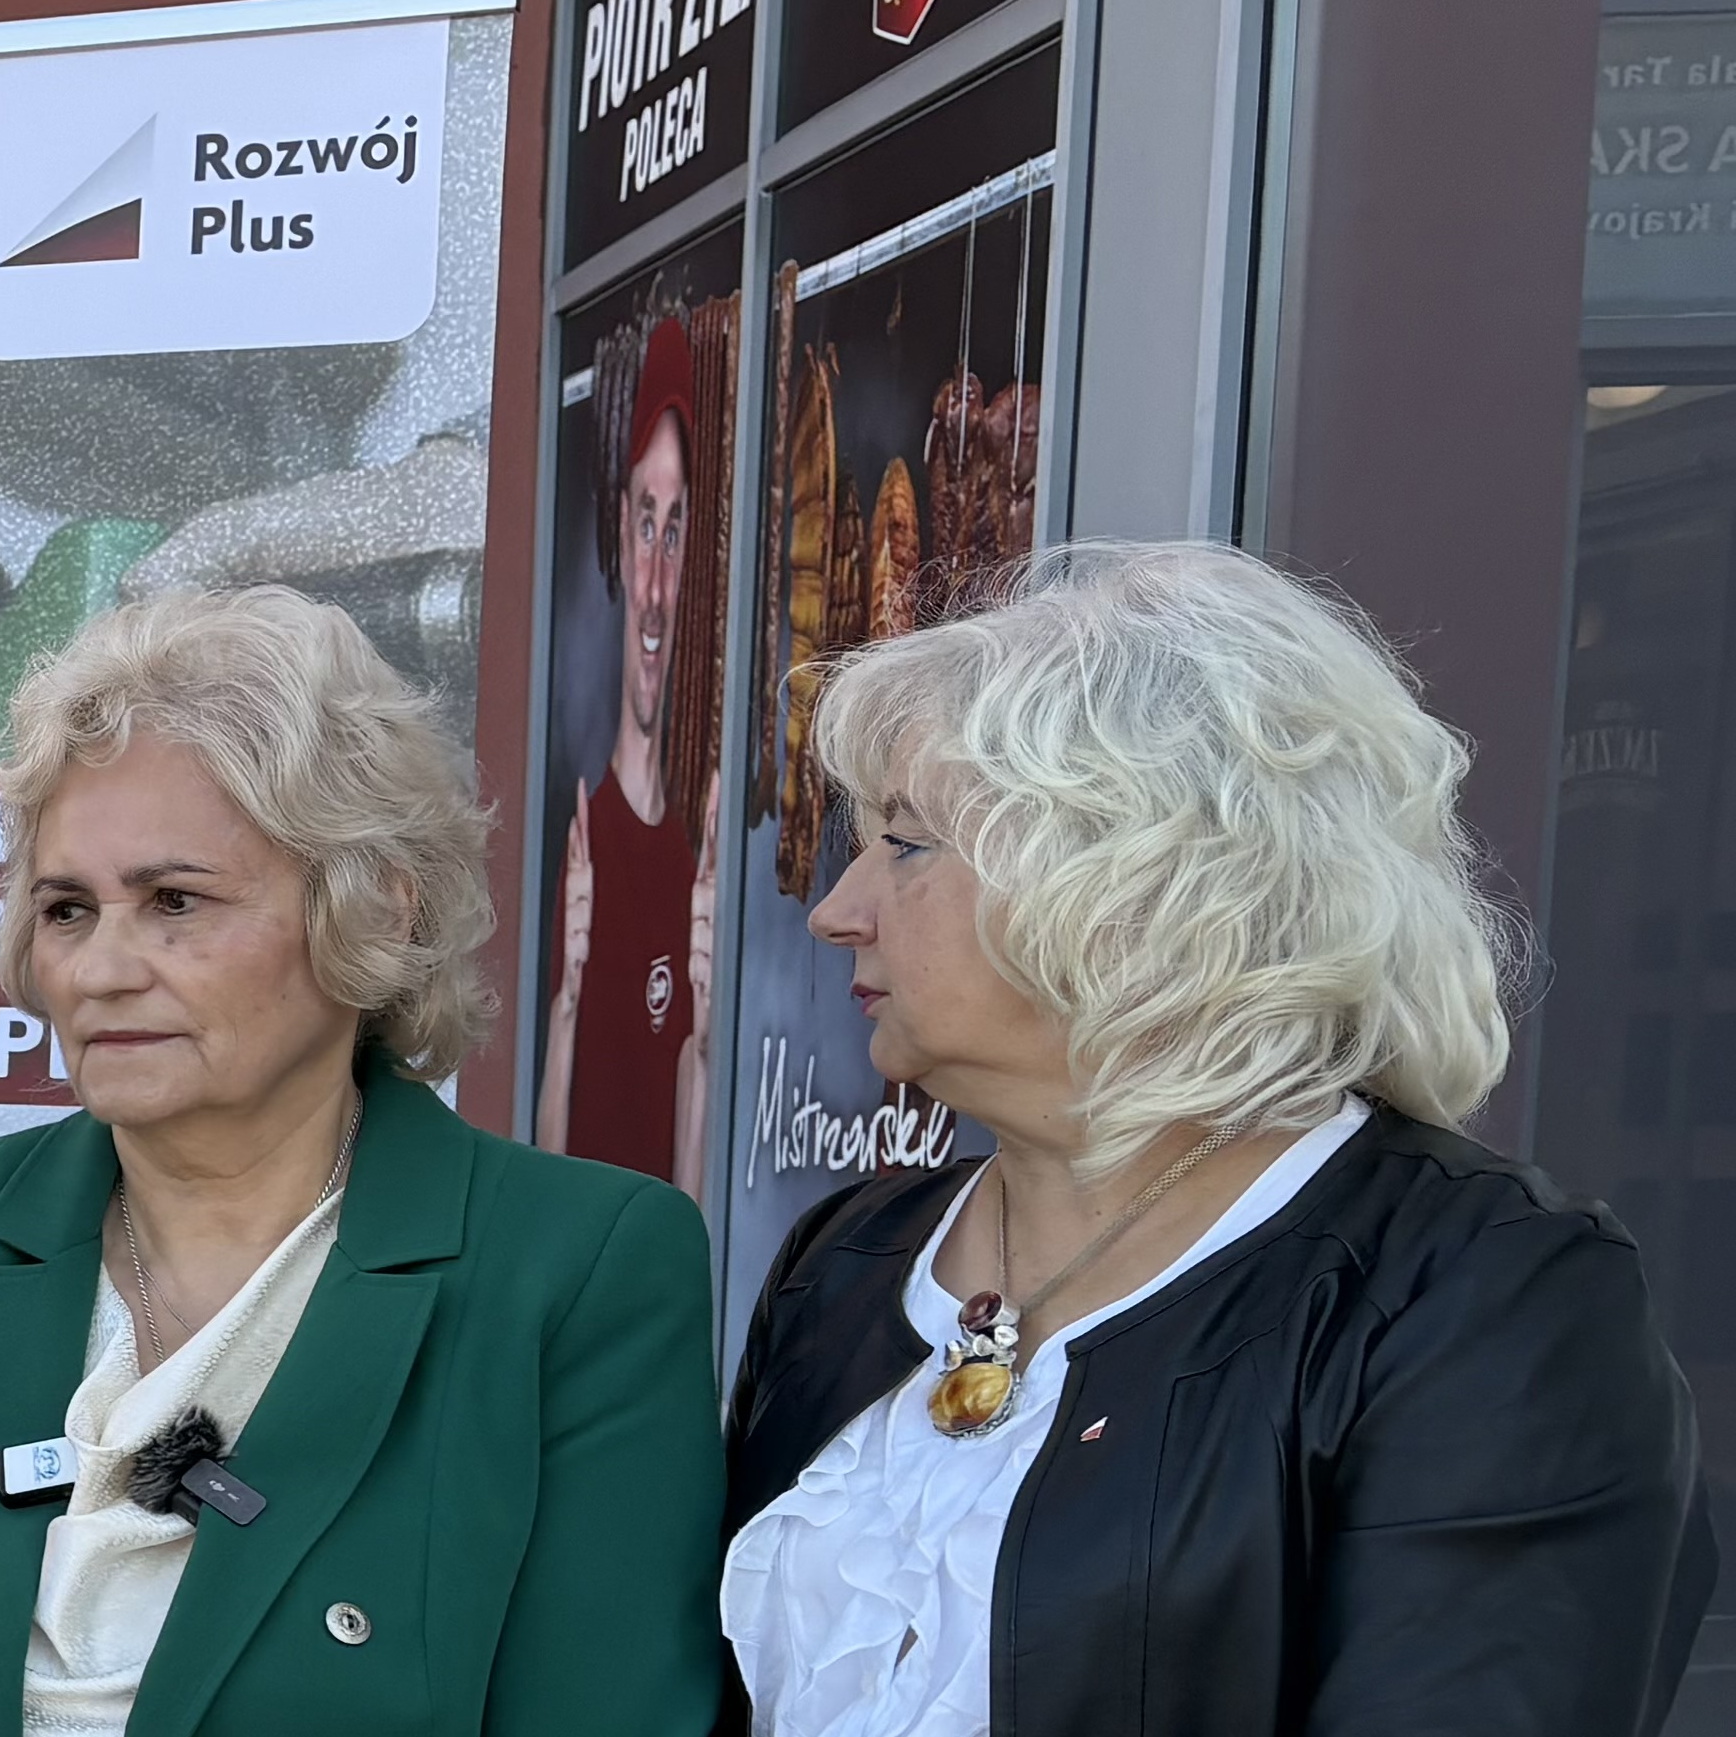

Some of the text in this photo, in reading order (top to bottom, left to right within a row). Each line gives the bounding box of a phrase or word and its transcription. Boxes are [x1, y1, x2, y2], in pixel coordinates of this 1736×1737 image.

[194, 115, 418, 184] Rozwój
[619, 66, 708, 203] POLECA
[190, 199, 314, 255] Plus
